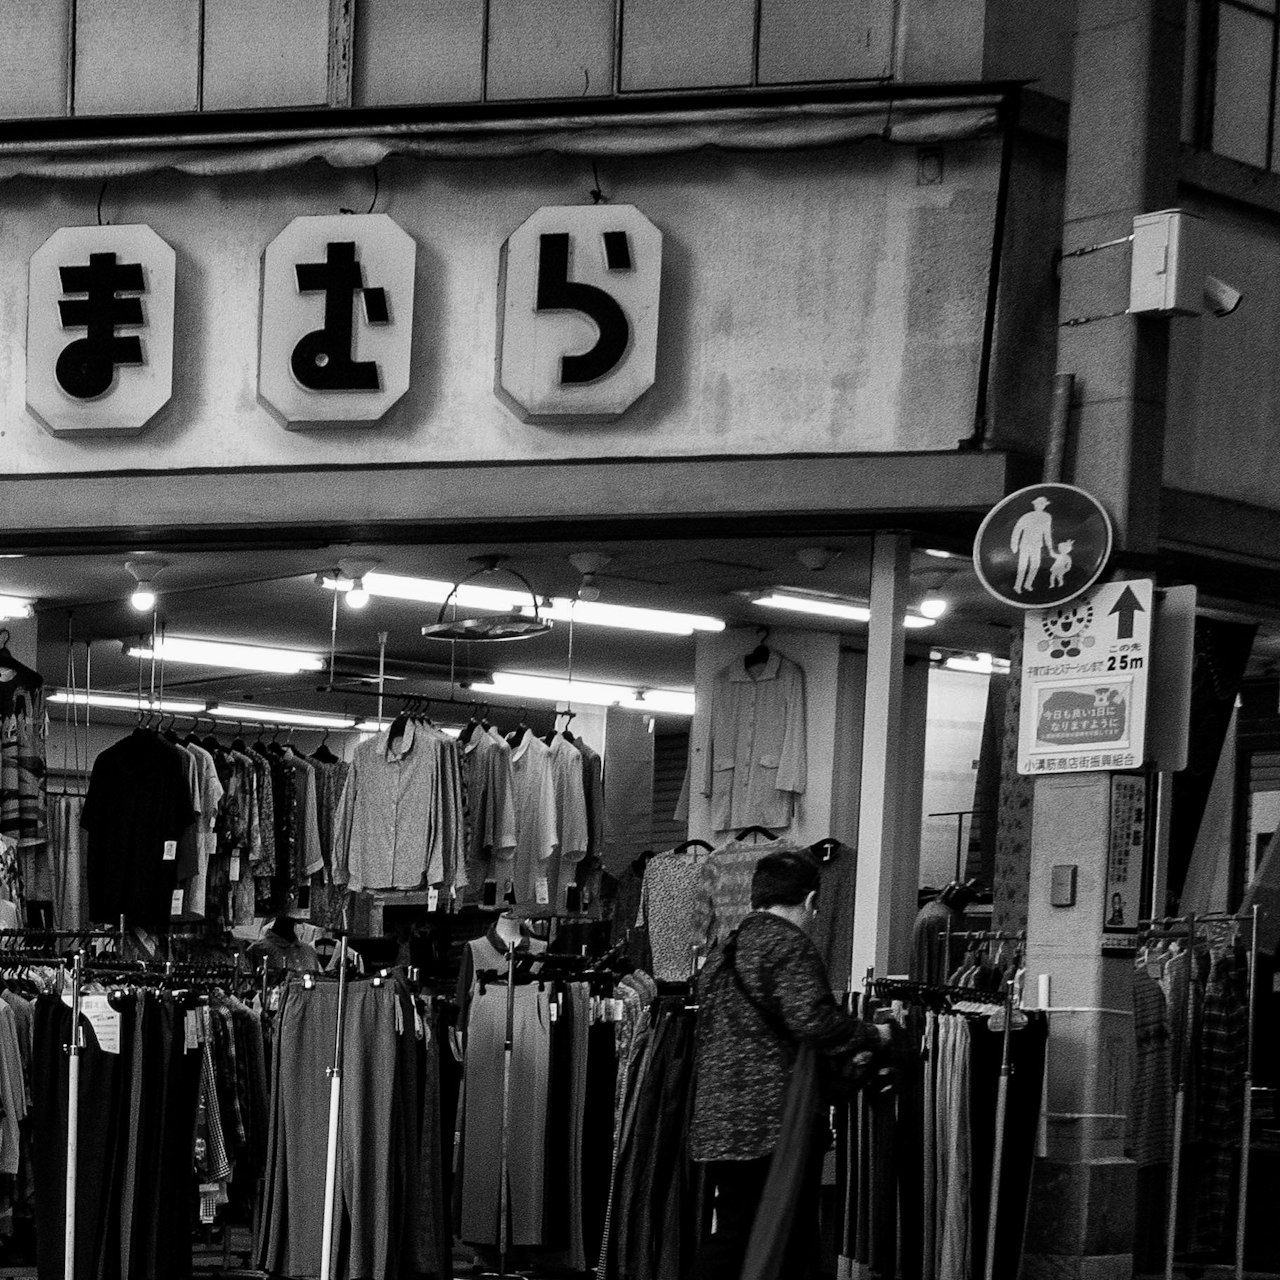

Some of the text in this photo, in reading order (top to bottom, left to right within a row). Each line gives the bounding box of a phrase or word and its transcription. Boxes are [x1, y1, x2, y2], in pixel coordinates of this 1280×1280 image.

[1108, 643, 1142, 654] この先
[1107, 654, 1144, 672] 25m
